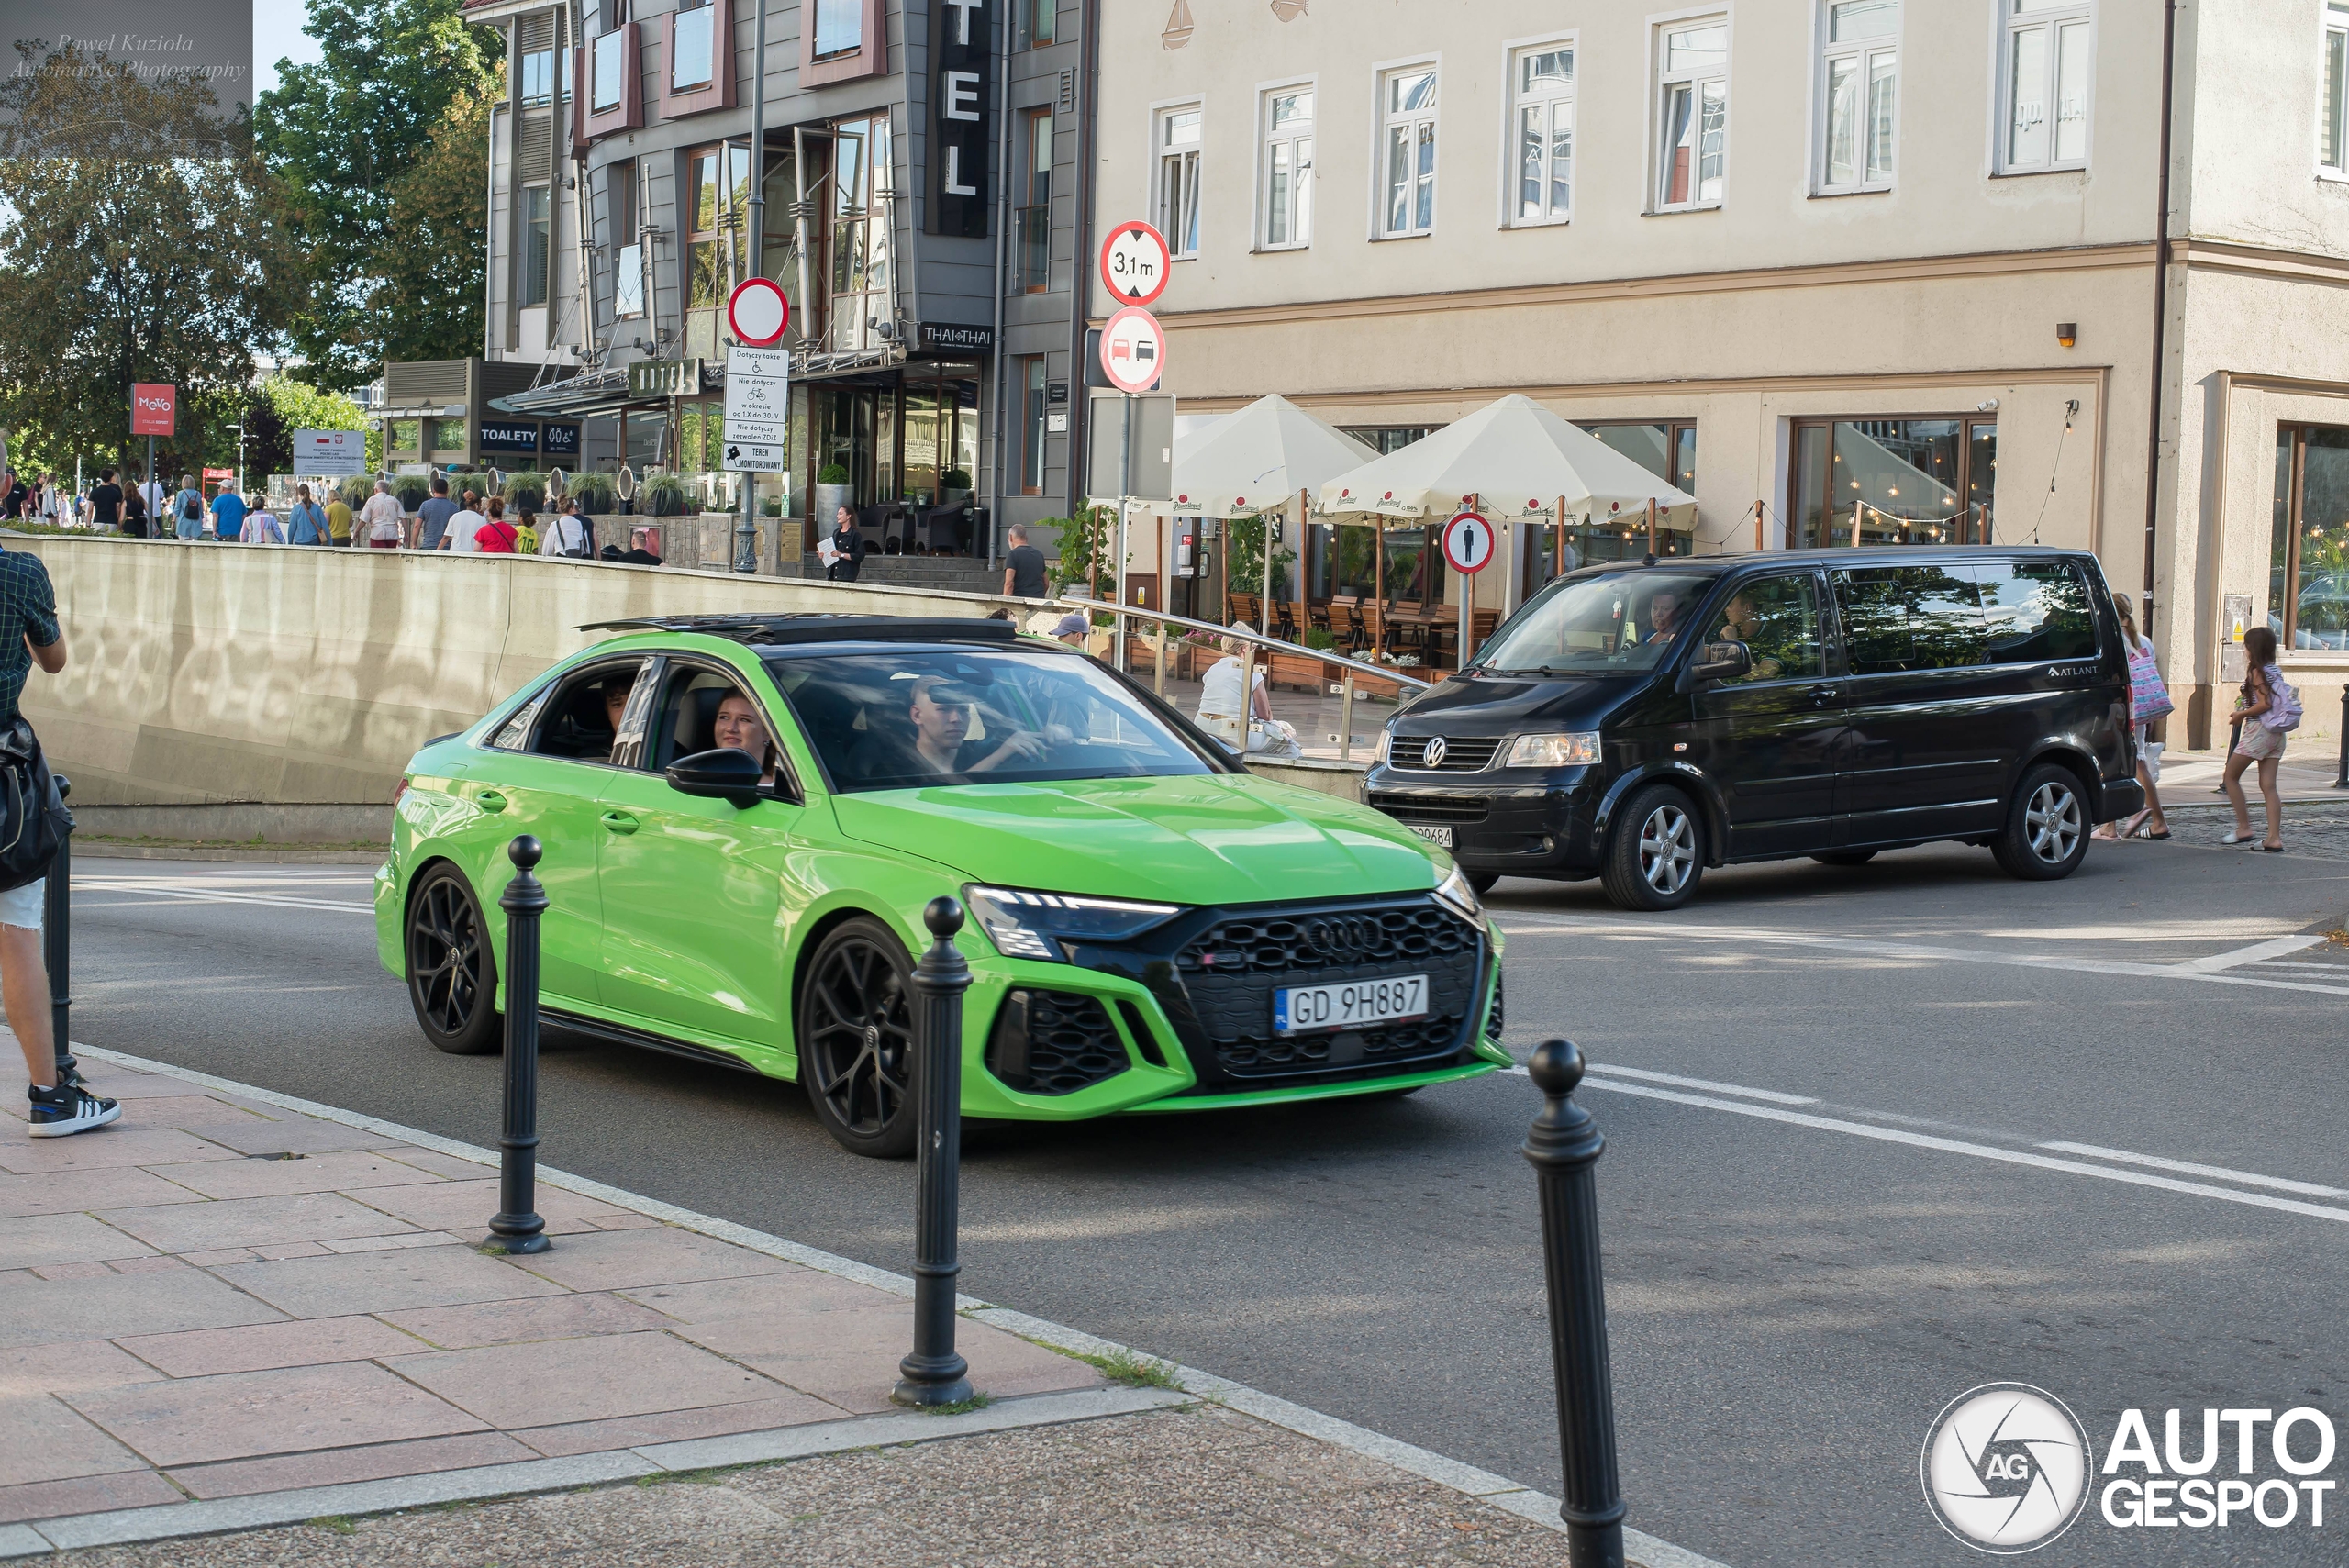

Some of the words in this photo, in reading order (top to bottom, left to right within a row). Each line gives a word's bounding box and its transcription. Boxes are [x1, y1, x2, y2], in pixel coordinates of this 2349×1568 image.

[736, 350, 762, 360] Dotyczy
[763, 351, 781, 361] także
[751, 378, 776, 387] dotyczy
[750, 425, 774, 433] dotyczy
[481, 428, 537, 442] TOALETY
[752, 448, 769, 457] TEREN
[739, 459, 781, 470] MONITOROWANY
[2060, 665, 2098, 676] ATLANT
[1294, 989, 1330, 1024] GD
[1341, 978, 1422, 1020] 9H887
